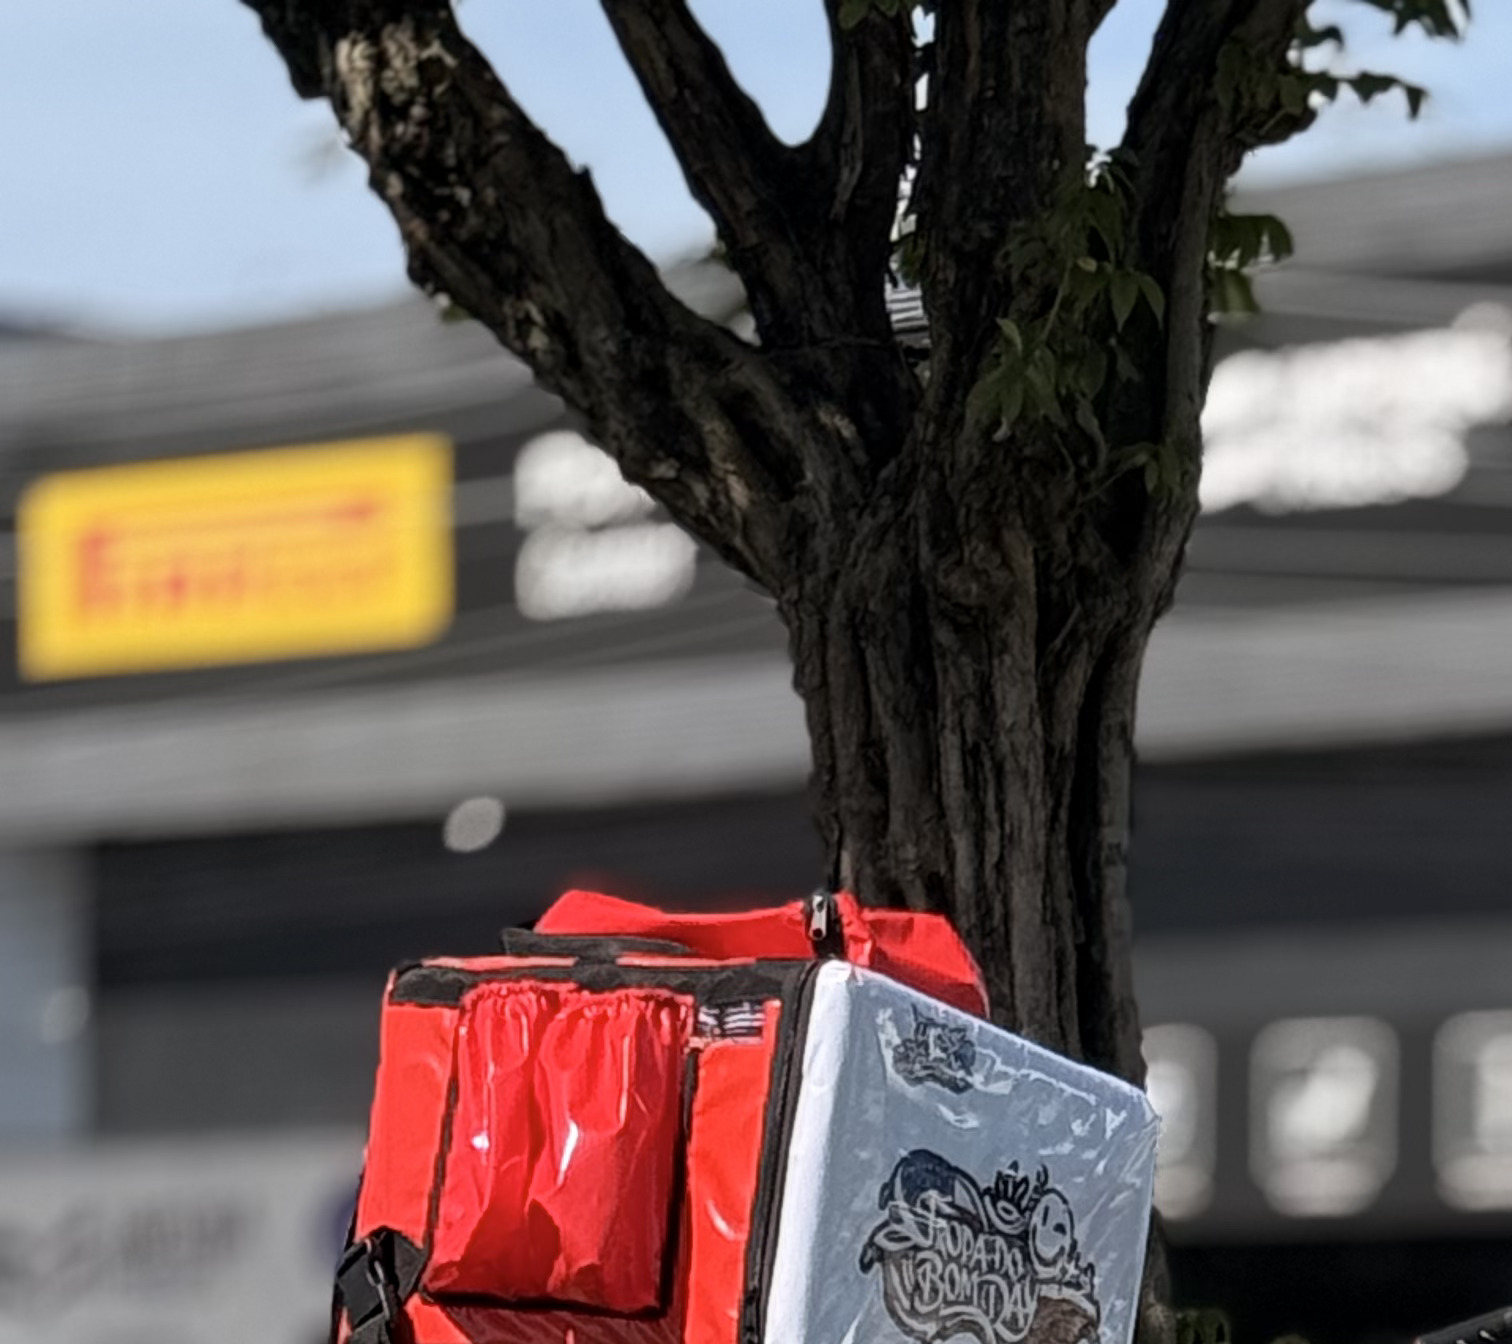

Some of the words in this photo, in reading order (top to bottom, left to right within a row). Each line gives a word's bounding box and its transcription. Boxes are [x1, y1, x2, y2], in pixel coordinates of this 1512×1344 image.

[910, 1191, 987, 1272] TROPA
[992, 1235, 1025, 1280] DO
[914, 1250, 979, 1314] BOM
[977, 1273, 1040, 1343] DAY
